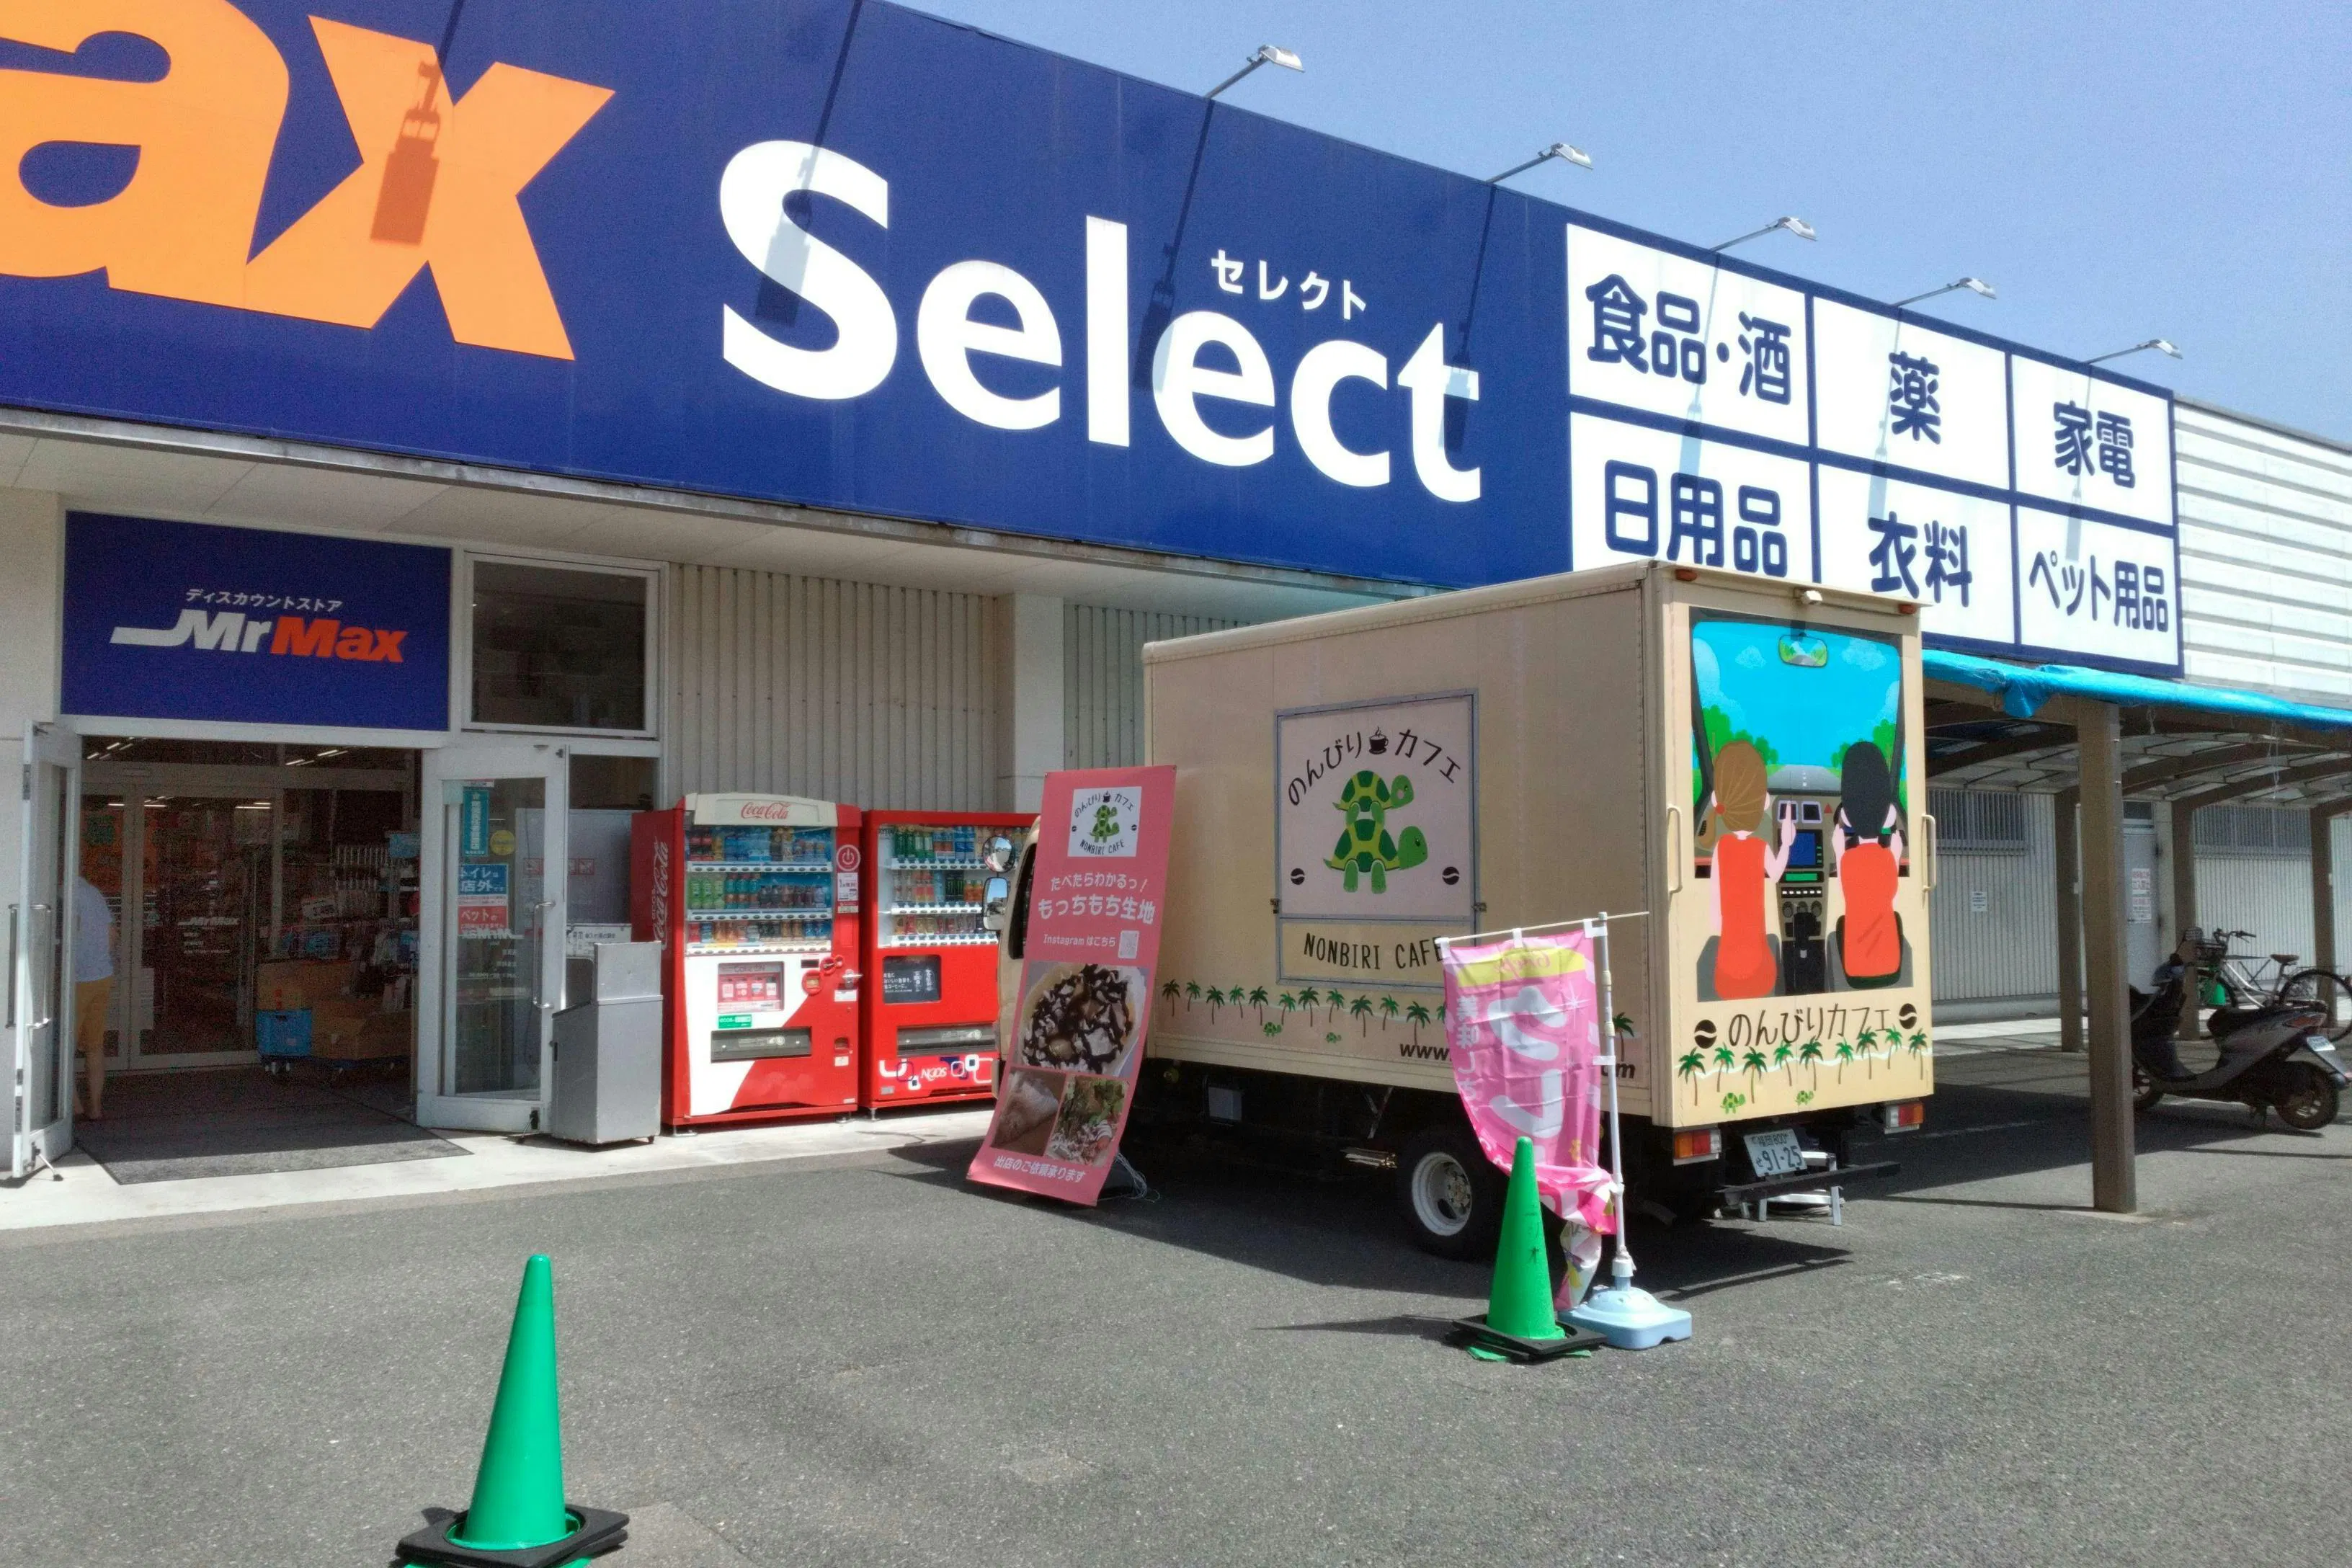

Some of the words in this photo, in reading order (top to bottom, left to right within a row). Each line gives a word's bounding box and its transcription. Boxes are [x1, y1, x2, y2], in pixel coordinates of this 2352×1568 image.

[1211, 249, 1367, 320] セレクト
[719, 140, 1481, 503] Select
[1585, 272, 1792, 406] 食品・酒
[1887, 349, 1942, 445] 薬
[2052, 400, 2136, 489] 家電
[1604, 458, 1788, 578] 日用品
[1868, 510, 1973, 607] 衣料
[2028, 548, 2169, 633] ペット用品
[185, 588, 344, 613] ディスカウントストア
[1288, 730, 1363, 806] のんびり
[1394, 728, 1461, 785] カフェ
[741, 801, 791, 819] Coca-Cola
[1074, 793, 1101, 818] のんびり
[1114, 793, 1134, 812] カフェ
[1079, 839, 1105, 856] NONBIRI
[1108, 839, 1125, 854] CAFE
[1038, 893, 1157, 925] もっちもち生地
[1043, 933, 1084, 947] Instagram
[1086, 935, 1116, 948] はこちら
[1304, 932, 1381, 971] NONBIRI
[1728, 1002, 1891, 1047] のんびりカフェ
